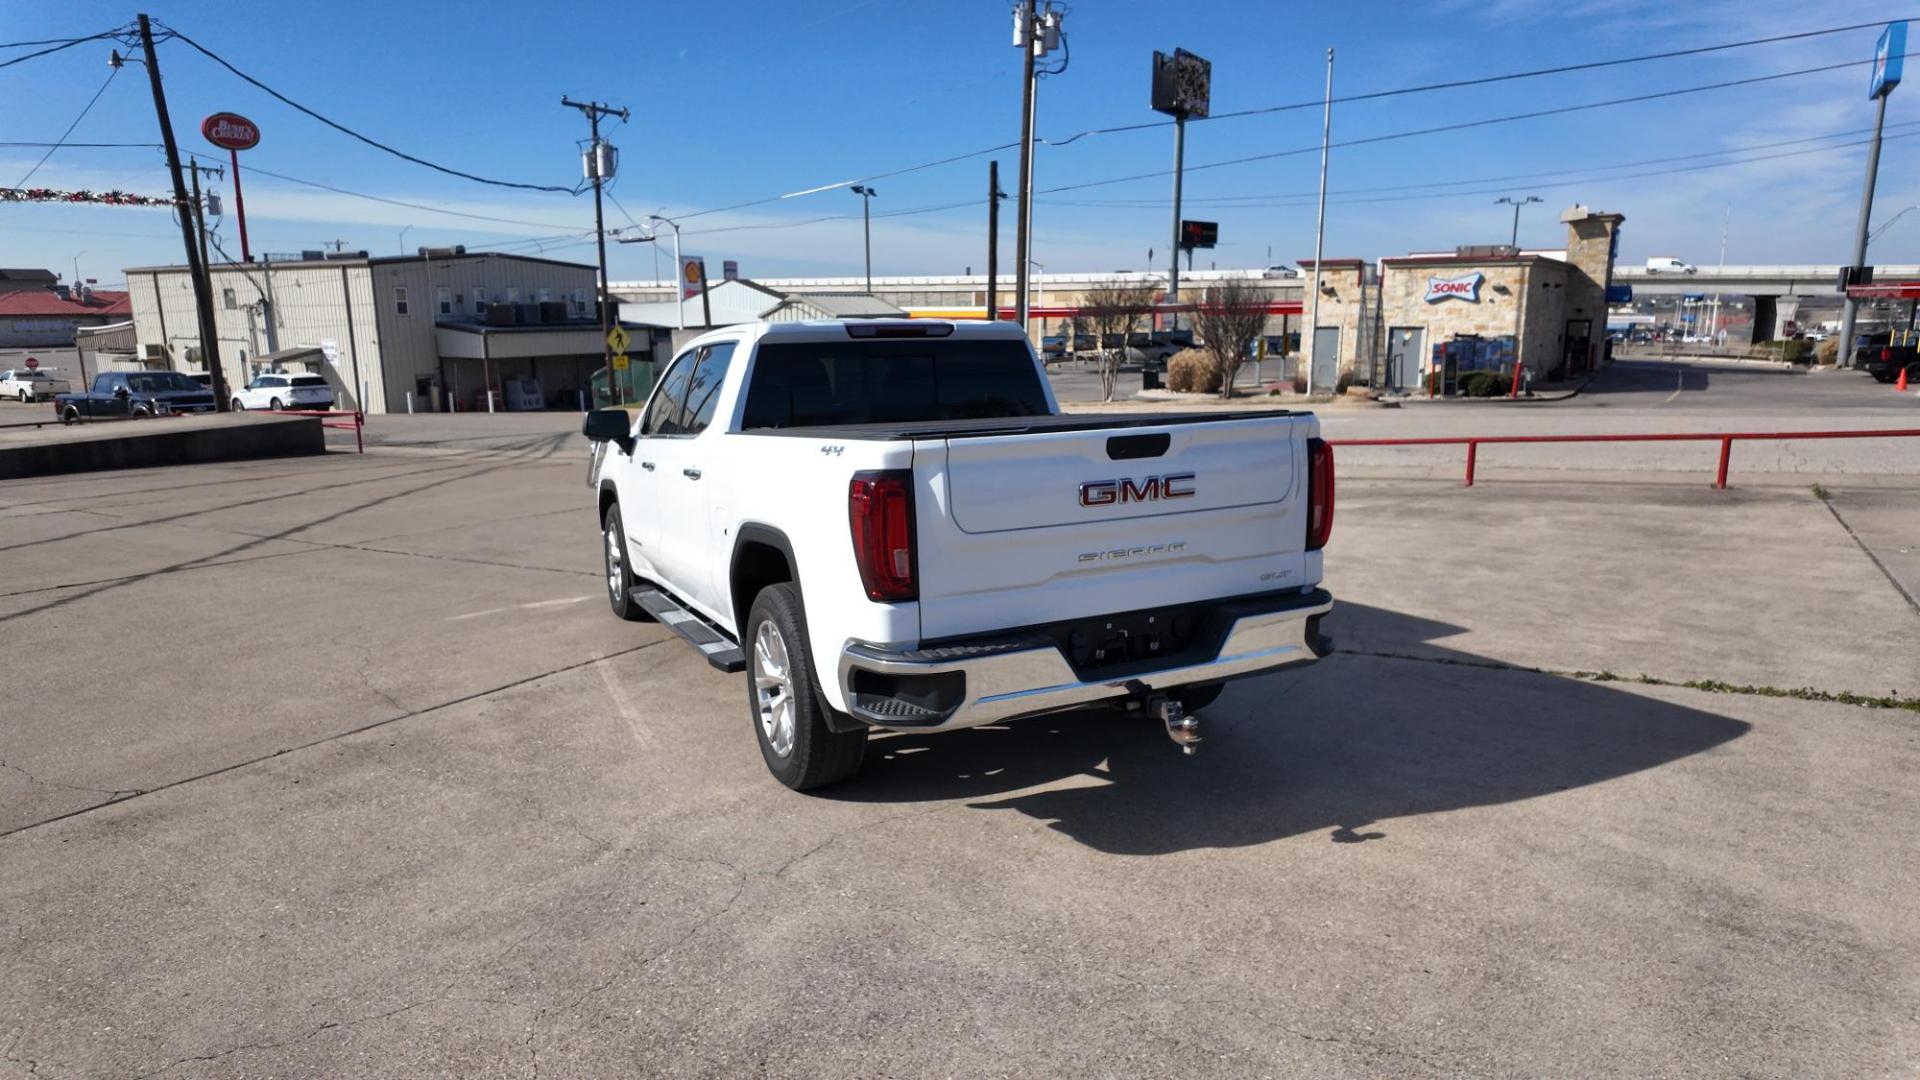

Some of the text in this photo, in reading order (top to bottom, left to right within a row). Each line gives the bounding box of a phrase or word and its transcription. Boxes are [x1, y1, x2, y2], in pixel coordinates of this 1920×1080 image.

[1432, 282, 1472, 293] SONIC
[1079, 472, 1195, 507] GMC
[1079, 541, 1187, 562] SIERRA
